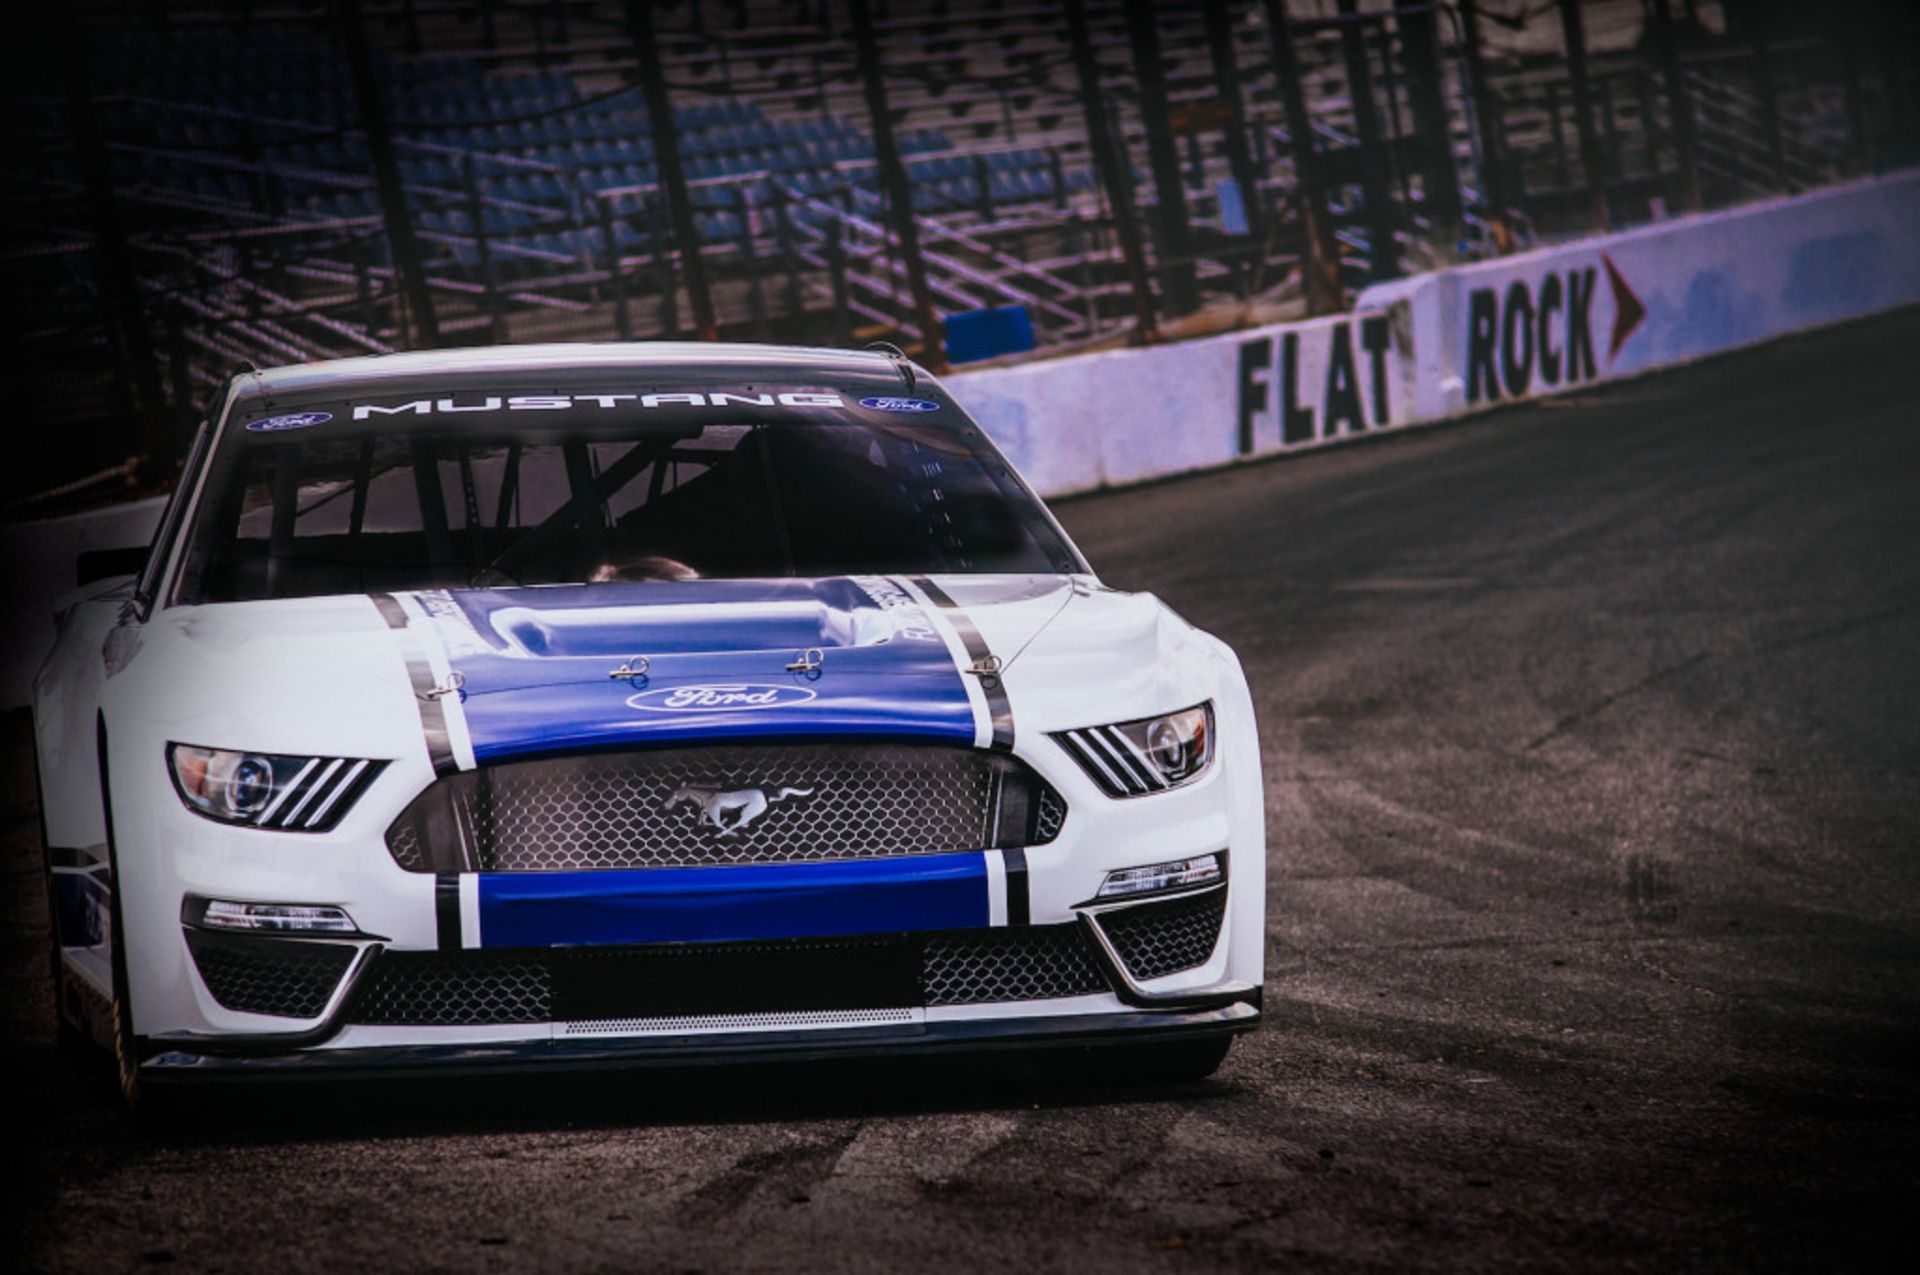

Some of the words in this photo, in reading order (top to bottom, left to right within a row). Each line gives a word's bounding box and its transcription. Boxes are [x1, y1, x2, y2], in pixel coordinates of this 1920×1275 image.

[1239, 317, 1389, 453] FLAT
[1466, 266, 1597, 403] ROCK
[353, 393, 844, 420] MUSTANG
[664, 686, 778, 707] Ford
